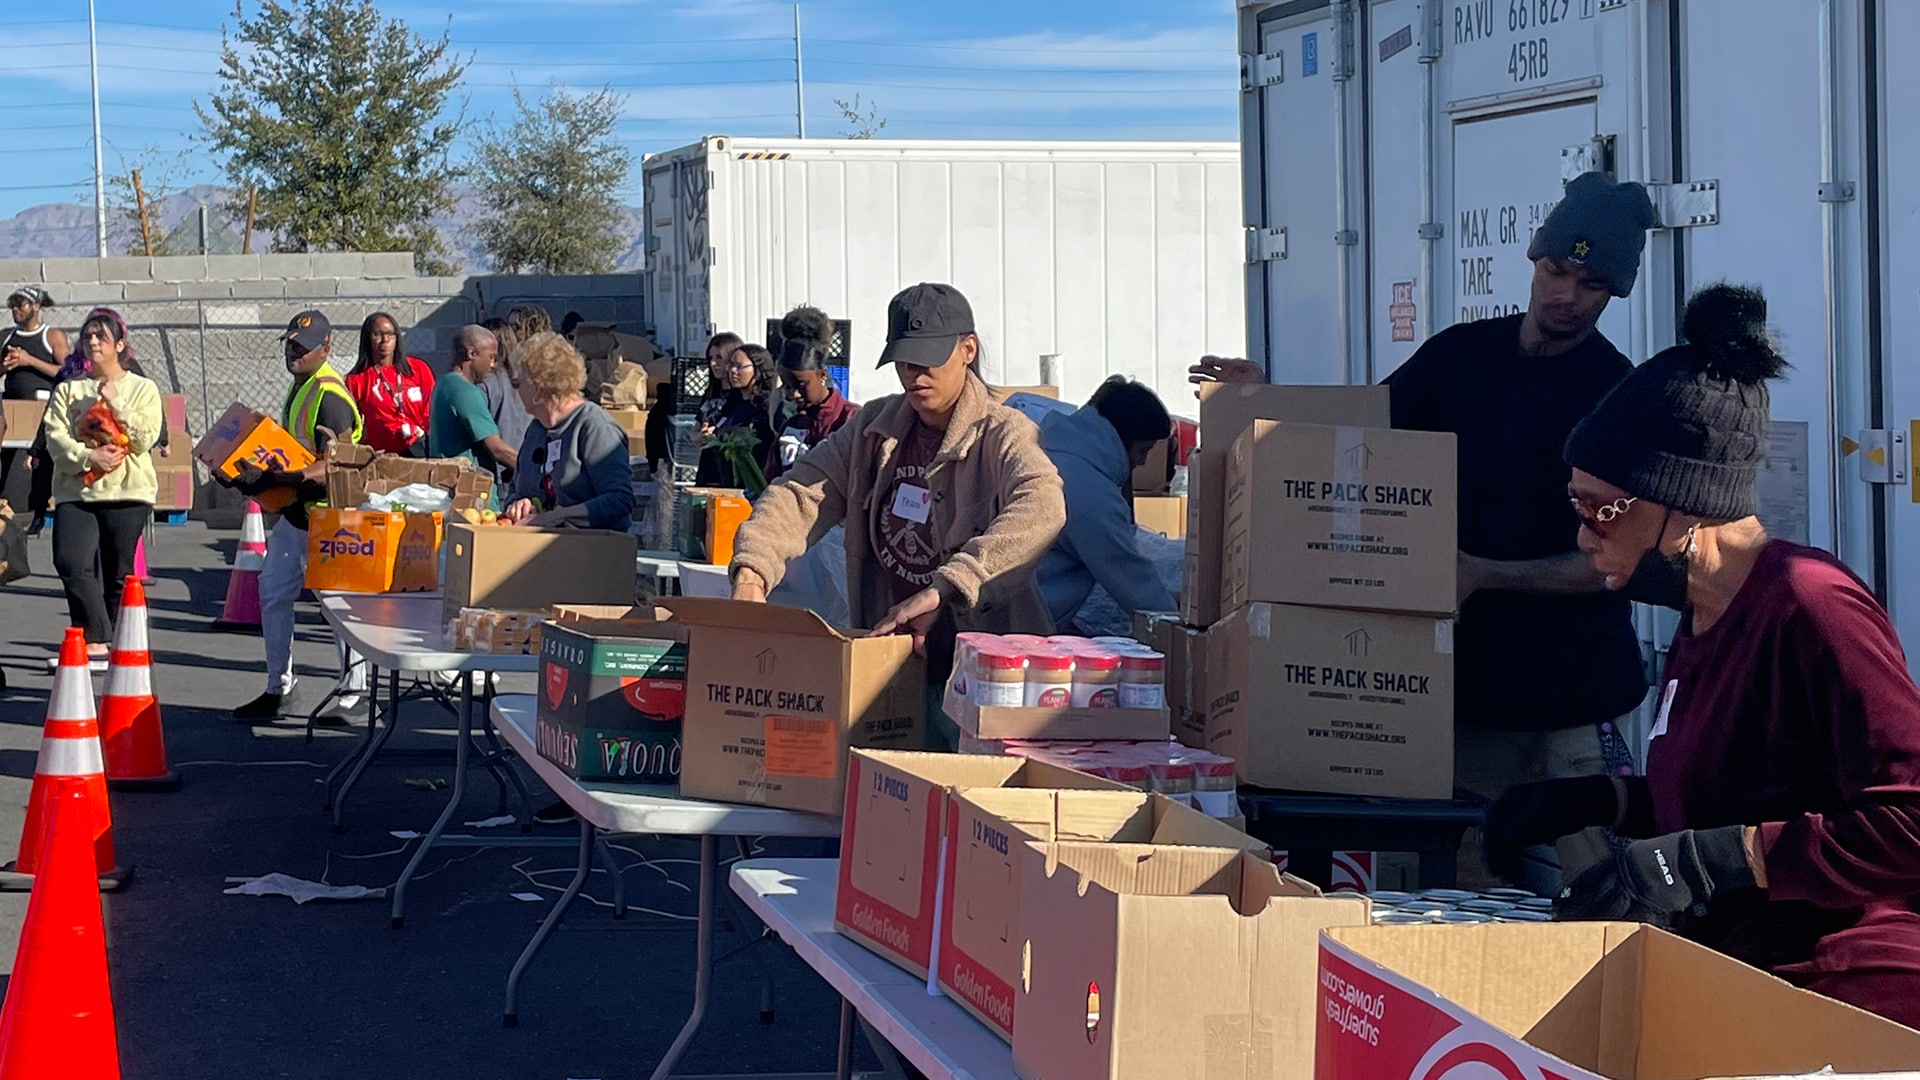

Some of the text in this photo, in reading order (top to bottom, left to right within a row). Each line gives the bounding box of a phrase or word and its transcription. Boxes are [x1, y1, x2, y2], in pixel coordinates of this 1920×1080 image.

[1455, 0, 1494, 45] RAVU
[1508, 37, 1549, 83] 45RB
[1460, 208, 1492, 248] MAX.
[1500, 206, 1520, 245] GR.
[1528, 203, 1556, 225] 34,0
[1461, 257, 1494, 296] TARE
[1283, 479, 1433, 507] THE PACK SHACK
[319, 539, 375, 558] peelz
[1306, 542, 1409, 556] WWW.THEPACKSHACK.ORG
[1376, 535, 1384, 543] AT
[896, 564, 937, 585] NATU
[1284, 663, 1430, 694] THE PACK SHACK
[707, 683, 825, 713] THE PACK SHACK
[1307, 728, 1407, 744] WWW.THEPACKSHACK.ORG
[602, 736, 682, 776] QUOIA
[873, 771, 909, 802] 12 PIECES
[972, 819, 1009, 856] 12 PIECES
[1653, 848, 1675, 886] HEAD
[852, 902, 910, 953] Golden Foods
[953, 963, 1012, 1027] Golden Foods
[1321, 966, 1385, 1020] growers.com
[1325, 996, 1379, 1047] superfresh
